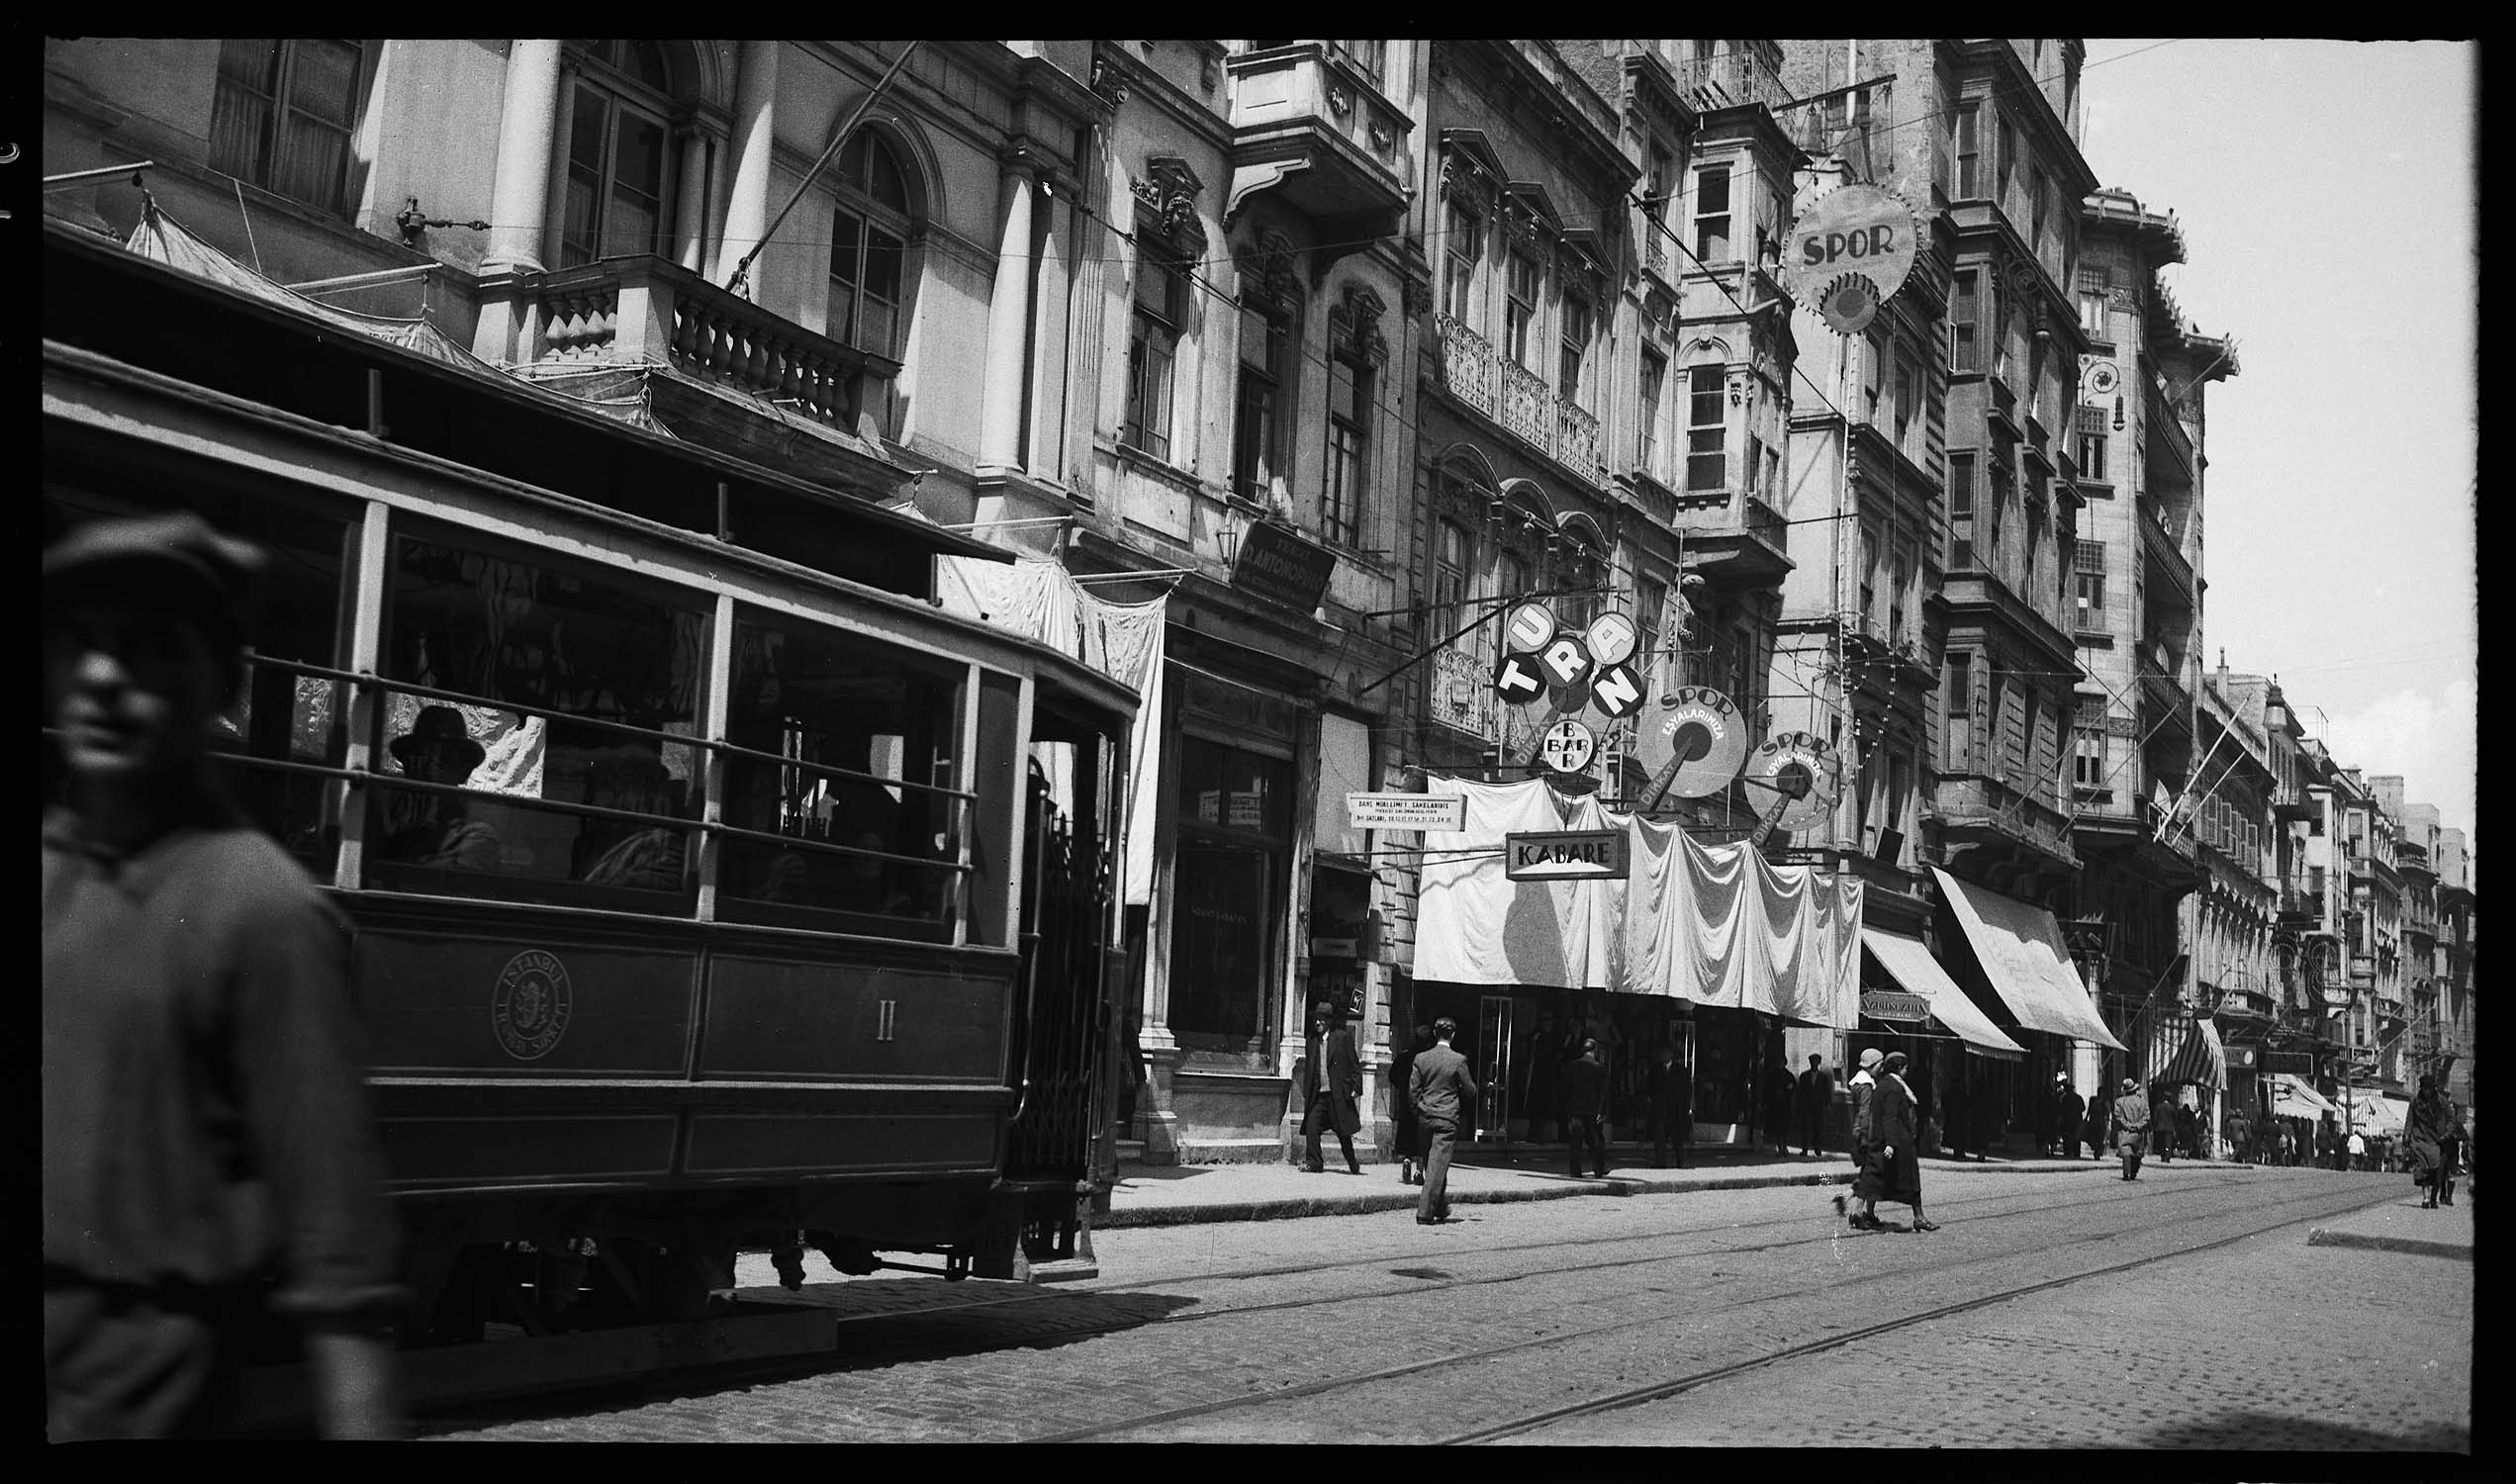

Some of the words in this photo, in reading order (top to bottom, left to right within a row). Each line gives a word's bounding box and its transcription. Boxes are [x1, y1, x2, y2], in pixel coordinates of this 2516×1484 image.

[1803, 225, 1895, 265] SPOR
[1660, 687, 1733, 721] SPOR
[1547, 739, 1589, 752] BAR
[1562, 722, 1576, 768] BAR
[1762, 731, 1830, 757] SPOR
[1518, 842, 1610, 866] KABARE
